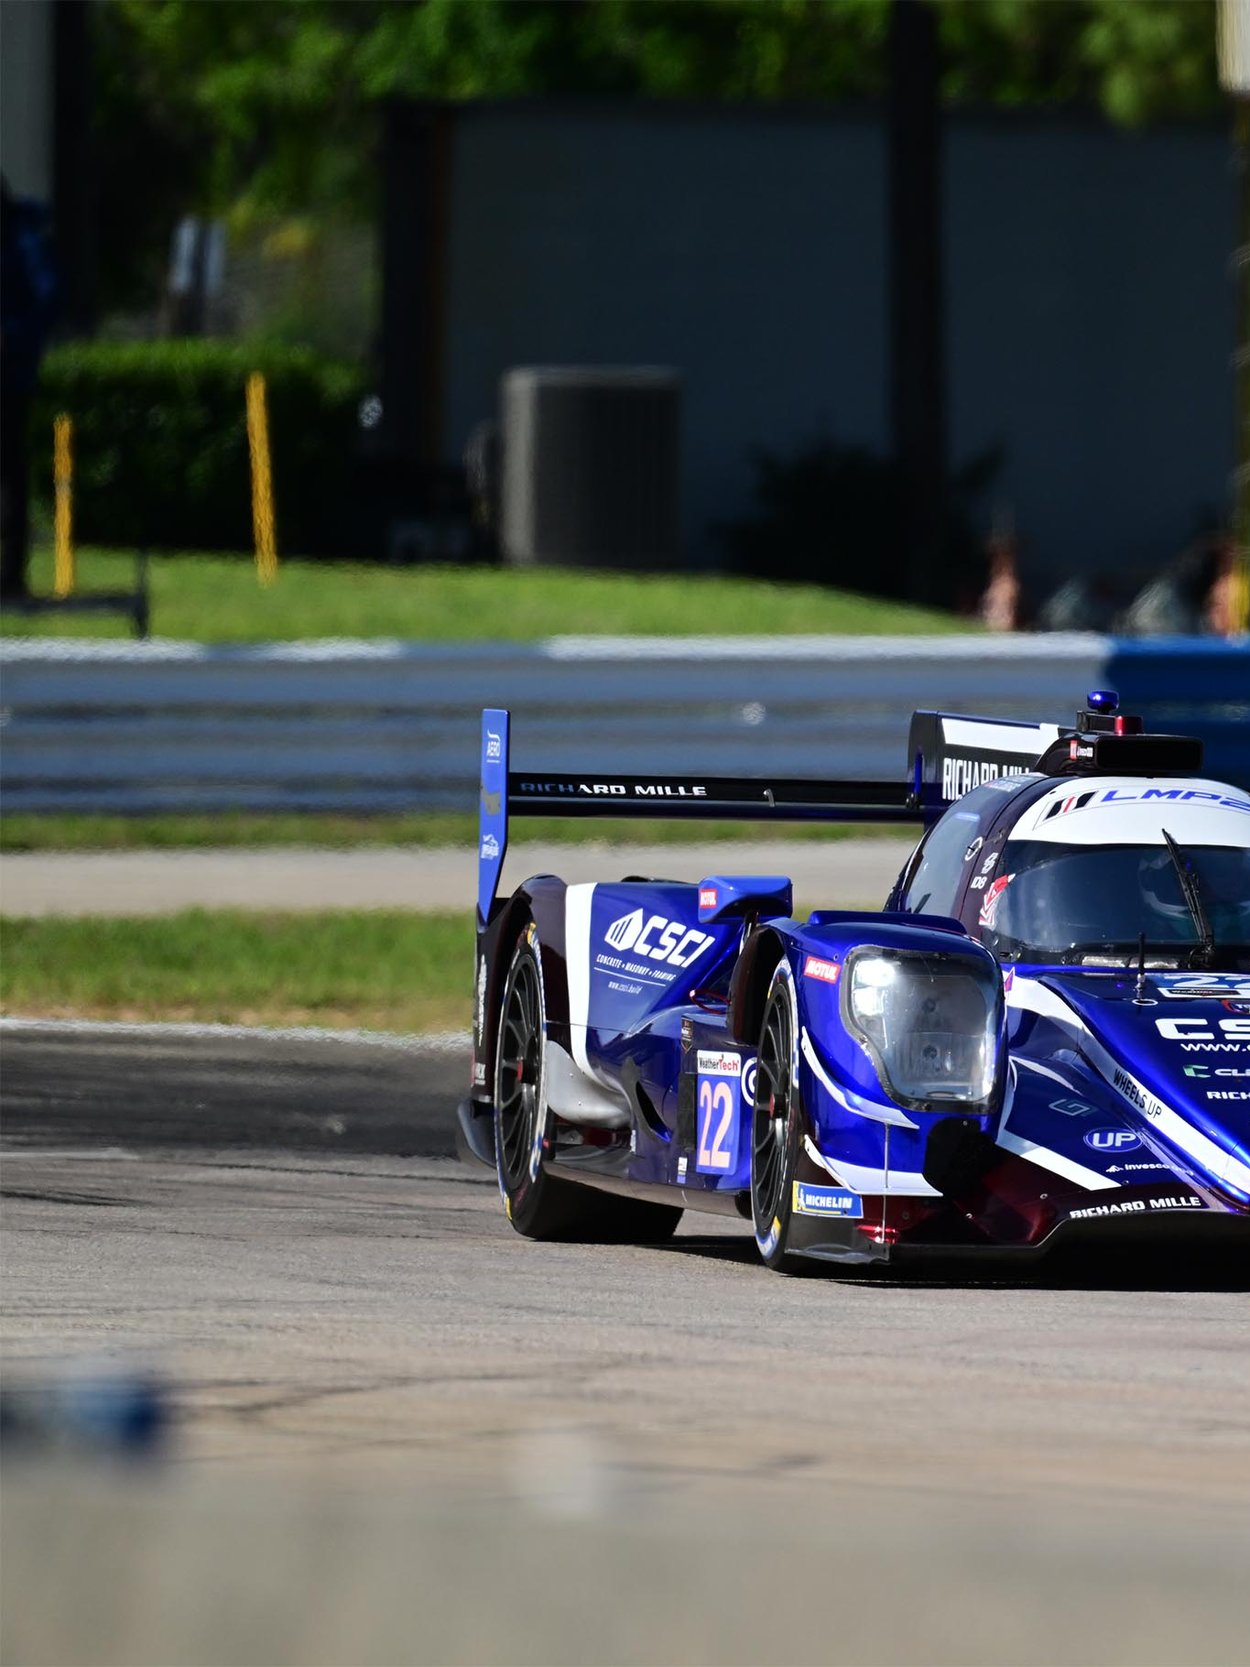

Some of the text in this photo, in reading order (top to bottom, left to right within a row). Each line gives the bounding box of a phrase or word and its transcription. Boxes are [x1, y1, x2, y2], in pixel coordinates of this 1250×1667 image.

[520, 782, 707, 796] RICHARD MILLE
[633, 915, 716, 968] CSCI
[805, 961, 837, 980] MOTUL
[1113, 1069, 1162, 1118] WHEELS UP
[698, 1080, 733, 1168] 22
[1092, 1132, 1136, 1147] UP
[805, 1194, 853, 1209] MICHELIN
[1069, 1196, 1201, 1219] RICHARD MILLE
